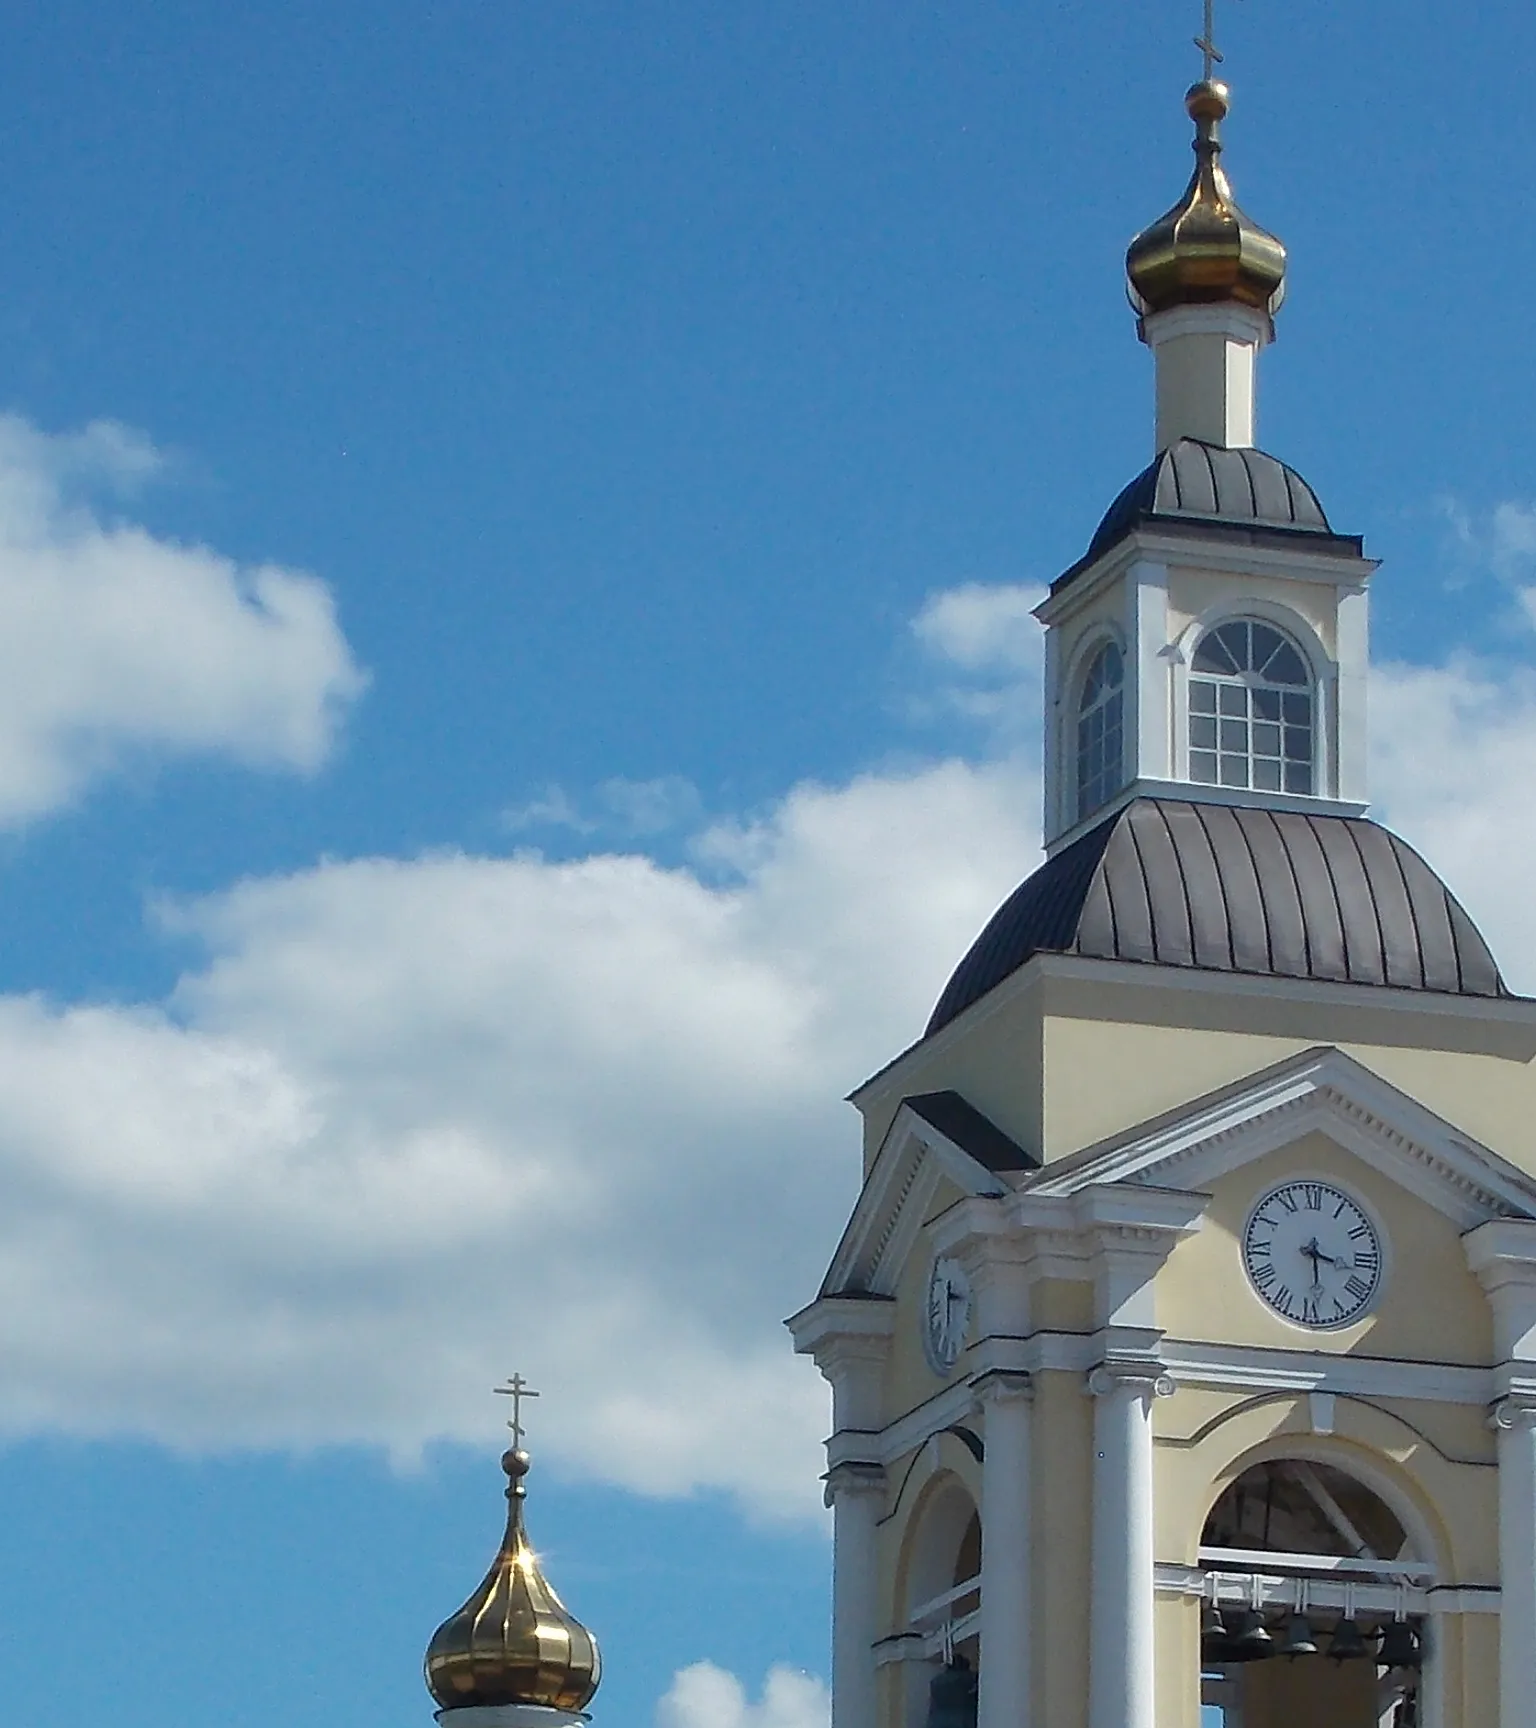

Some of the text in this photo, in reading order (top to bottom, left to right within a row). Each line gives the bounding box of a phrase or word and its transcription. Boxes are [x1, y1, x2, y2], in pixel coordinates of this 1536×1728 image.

[1304, 1185, 1323, 1211] XII
[1333, 1199, 1347, 1219] I
[1348, 1225, 1366, 1240] II
[1354, 1252, 1373, 1269] III
